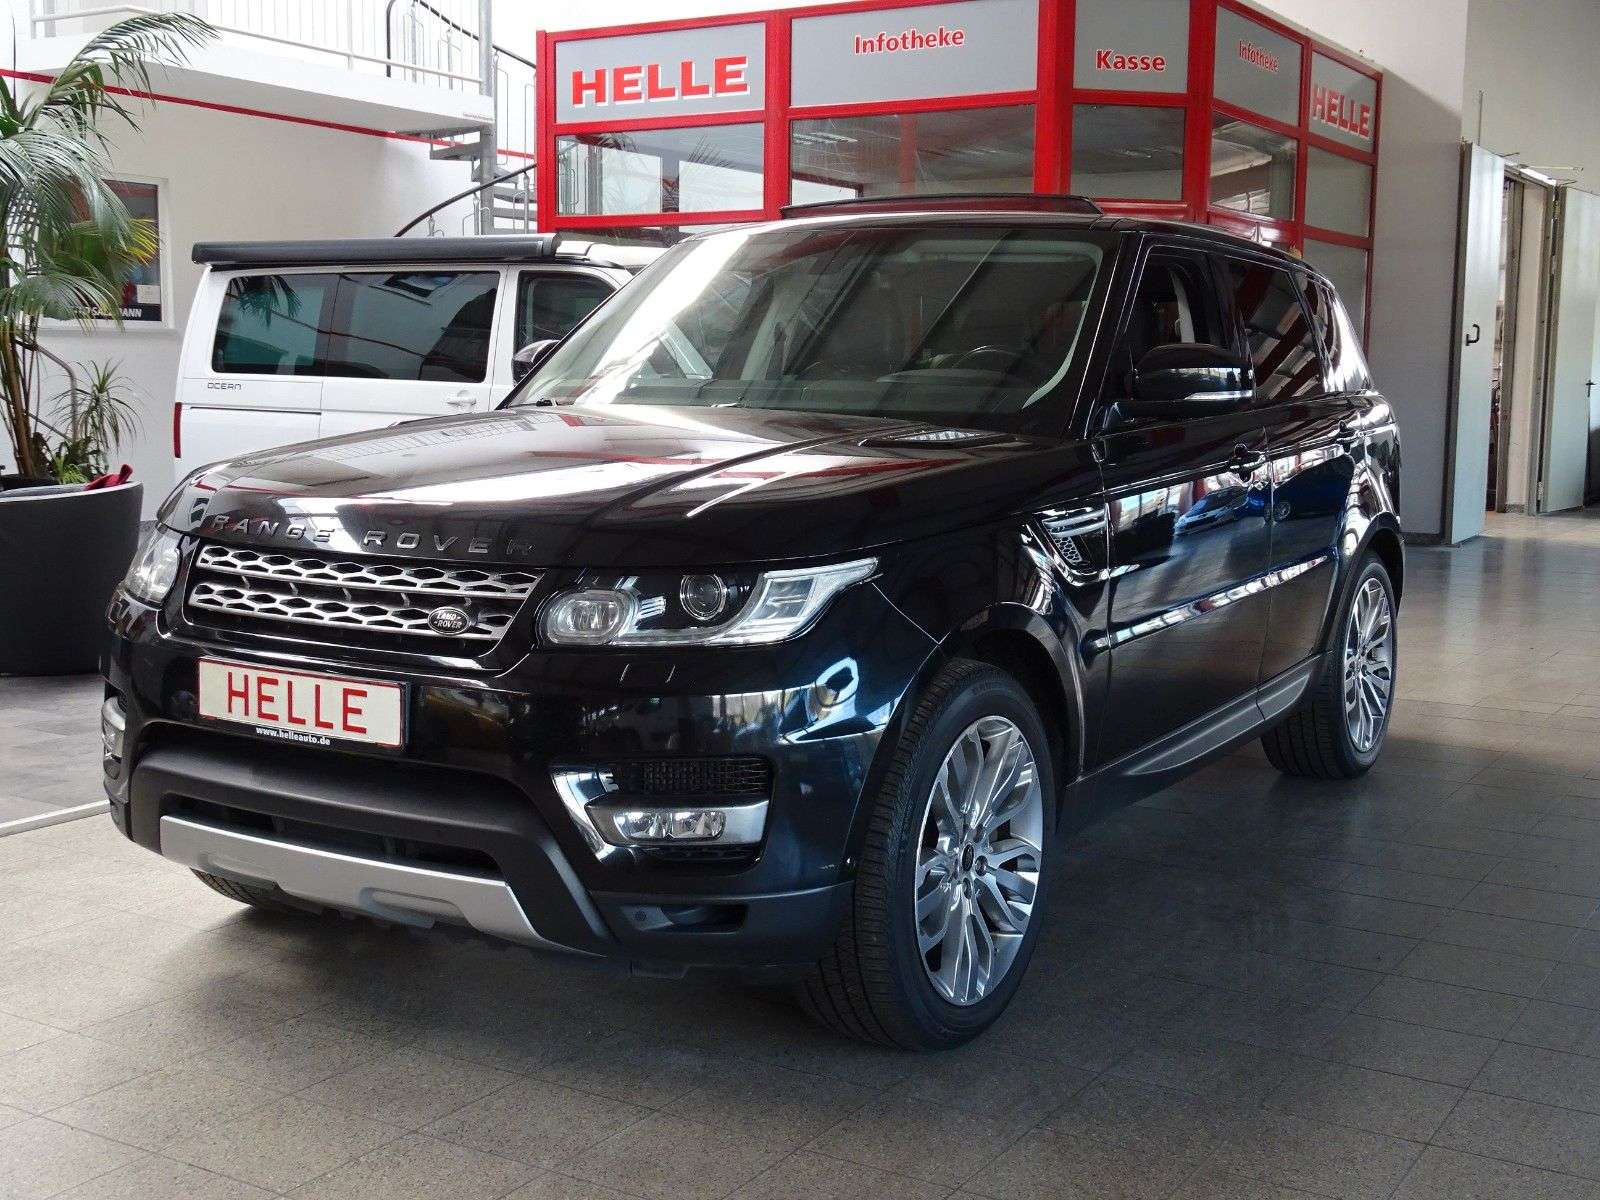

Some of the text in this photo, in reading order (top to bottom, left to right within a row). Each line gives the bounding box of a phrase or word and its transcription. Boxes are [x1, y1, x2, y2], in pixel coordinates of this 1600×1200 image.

[855, 27, 965, 54] Infotheke
[1239, 40, 1279, 72] Infotheke
[1096, 50, 1165, 71] Kasse
[572, 55, 750, 108] HELLE
[1311, 85, 1371, 139] HELLE
[207, 382, 242, 390] OCEAN
[212, 514, 535, 555] RANGE ROVER
[228, 672, 367, 734] HELLE
[256, 727, 331, 746] www.helleauto.de
